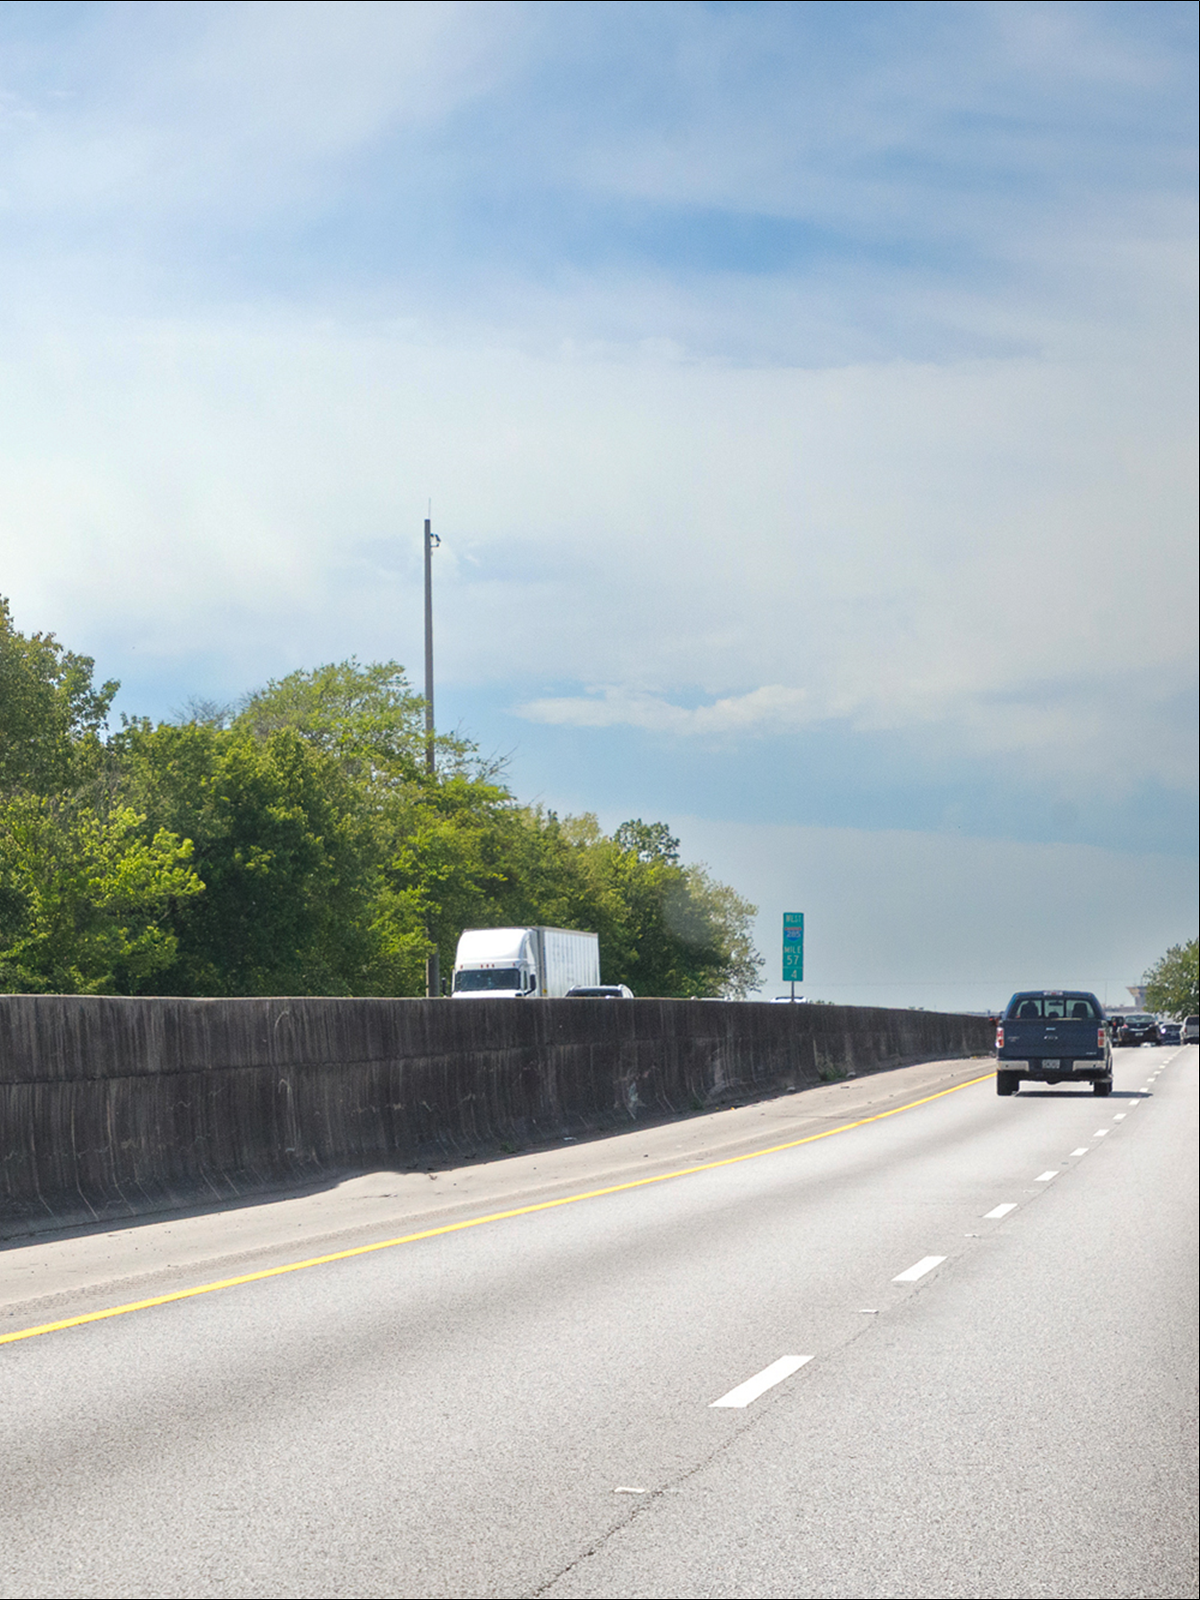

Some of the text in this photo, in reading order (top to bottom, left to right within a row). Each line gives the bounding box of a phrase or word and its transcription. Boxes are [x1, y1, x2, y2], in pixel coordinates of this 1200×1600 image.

[784, 945, 801, 954] MILE
[787, 955, 799, 965] 57
[791, 969, 797, 979] 4
